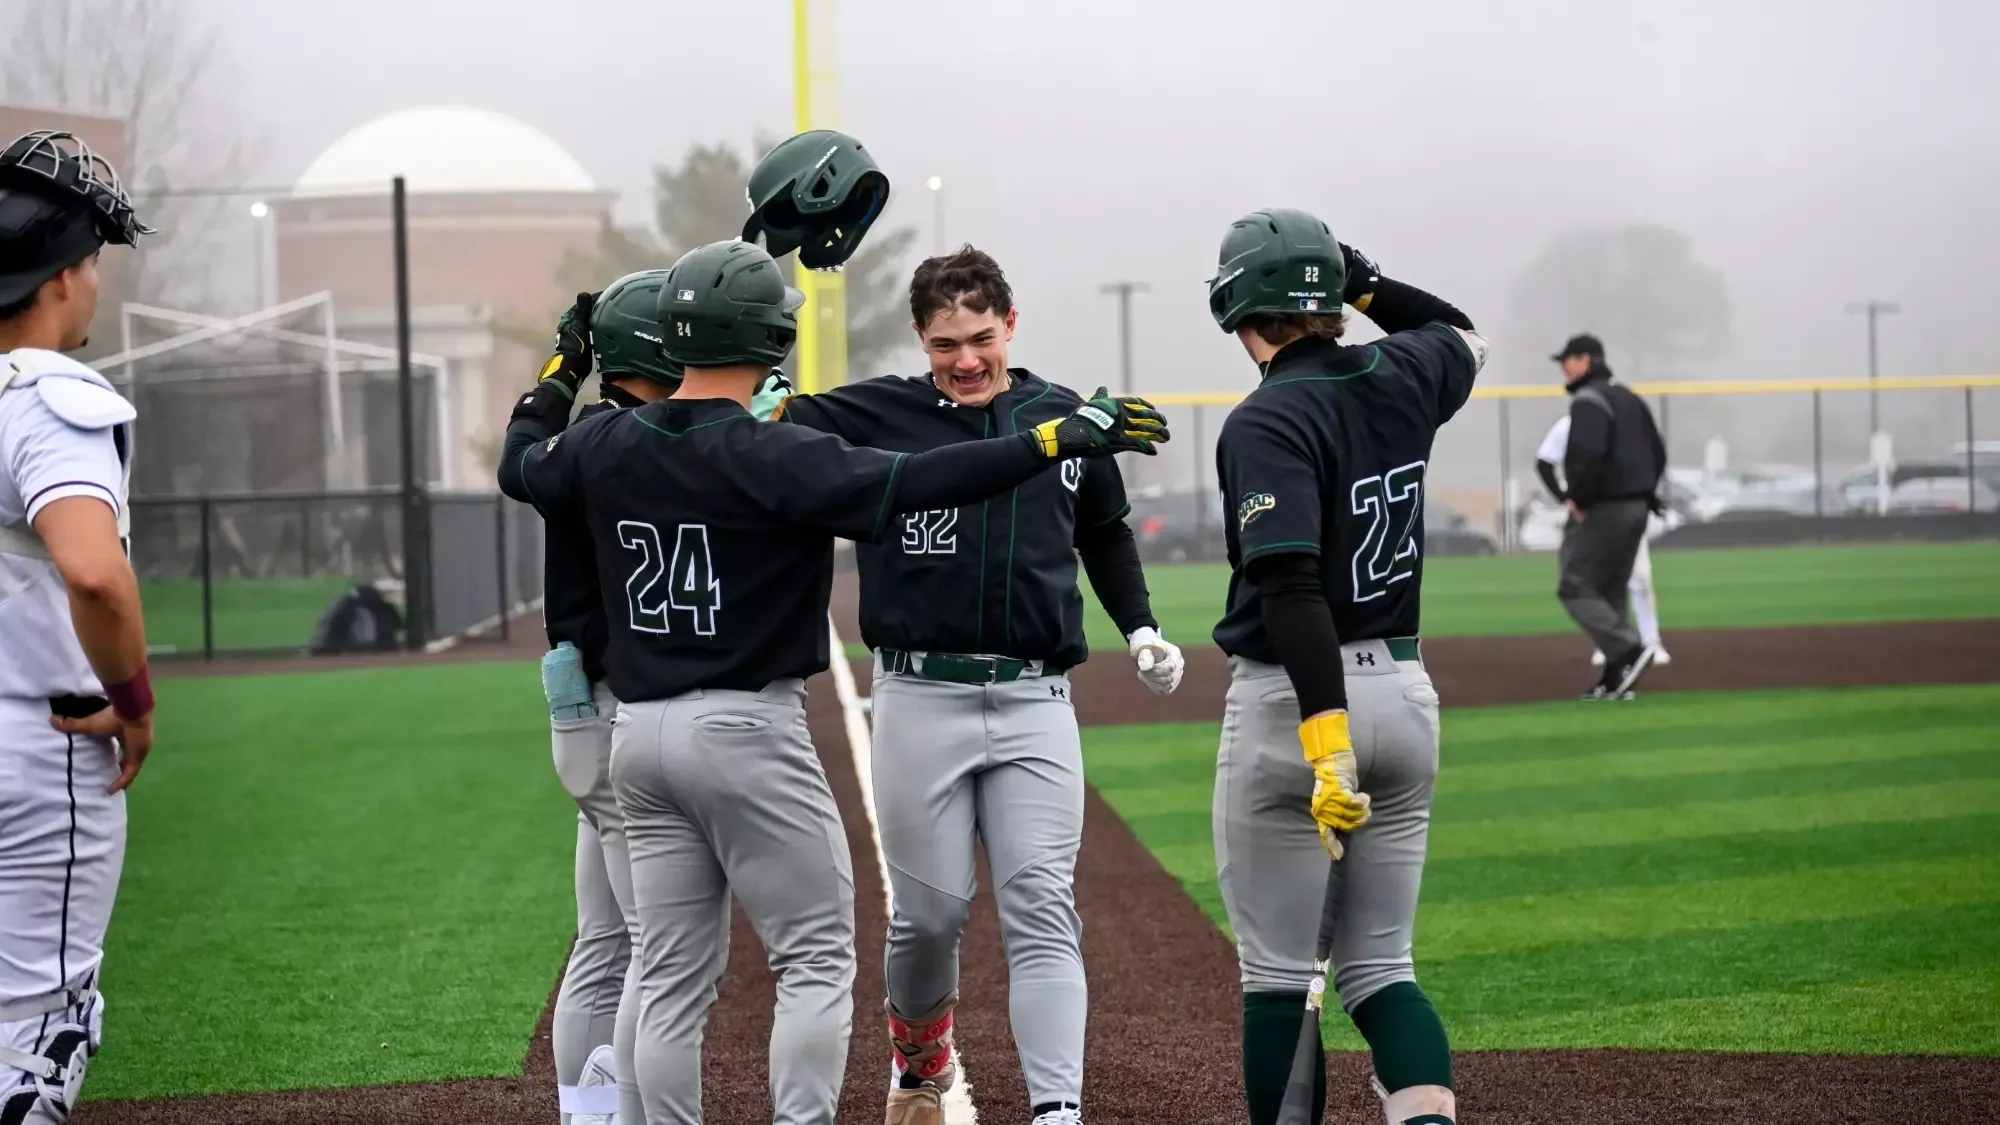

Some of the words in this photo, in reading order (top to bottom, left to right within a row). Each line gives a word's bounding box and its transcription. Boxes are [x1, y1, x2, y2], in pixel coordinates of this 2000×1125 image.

[1305, 266, 1319, 283] 22
[676, 321, 692, 337] 24
[901, 507, 959, 554] 32
[1351, 460, 1427, 603] 22
[617, 520, 721, 636] 24
